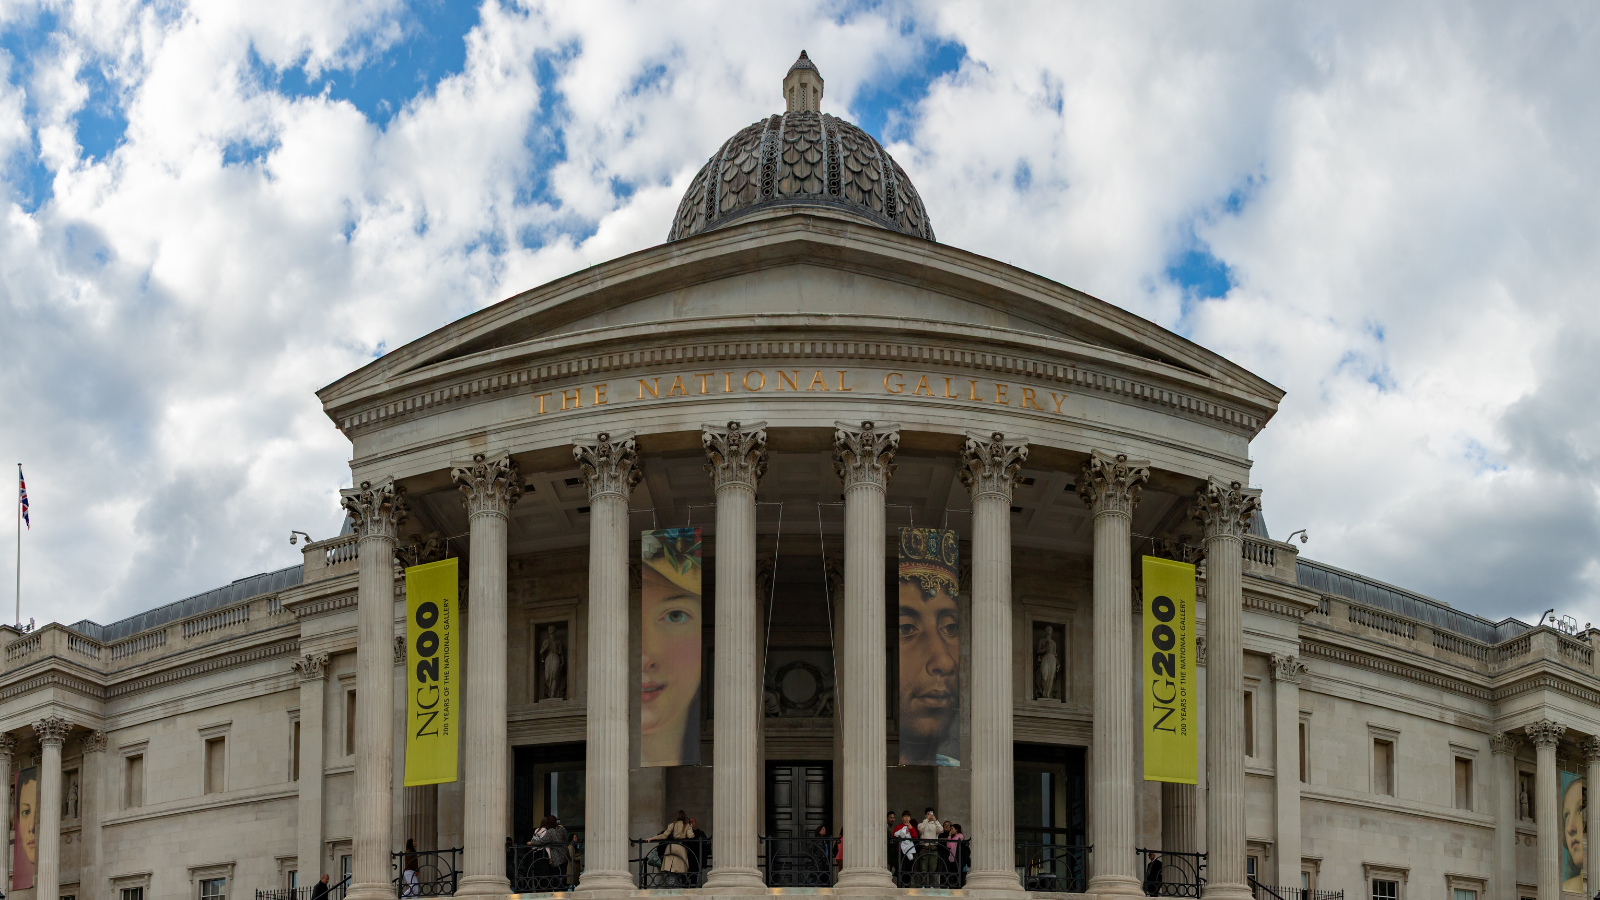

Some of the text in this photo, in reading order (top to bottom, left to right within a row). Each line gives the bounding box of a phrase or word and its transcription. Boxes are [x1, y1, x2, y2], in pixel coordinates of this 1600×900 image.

[532, 370, 1070, 415] THE NATIONAL GALLERY
[415, 601, 440, 740] NG200
[1151, 595, 1177, 735] NG200
[444, 687, 450, 698] OF
[1181, 687, 1187, 697] OF
